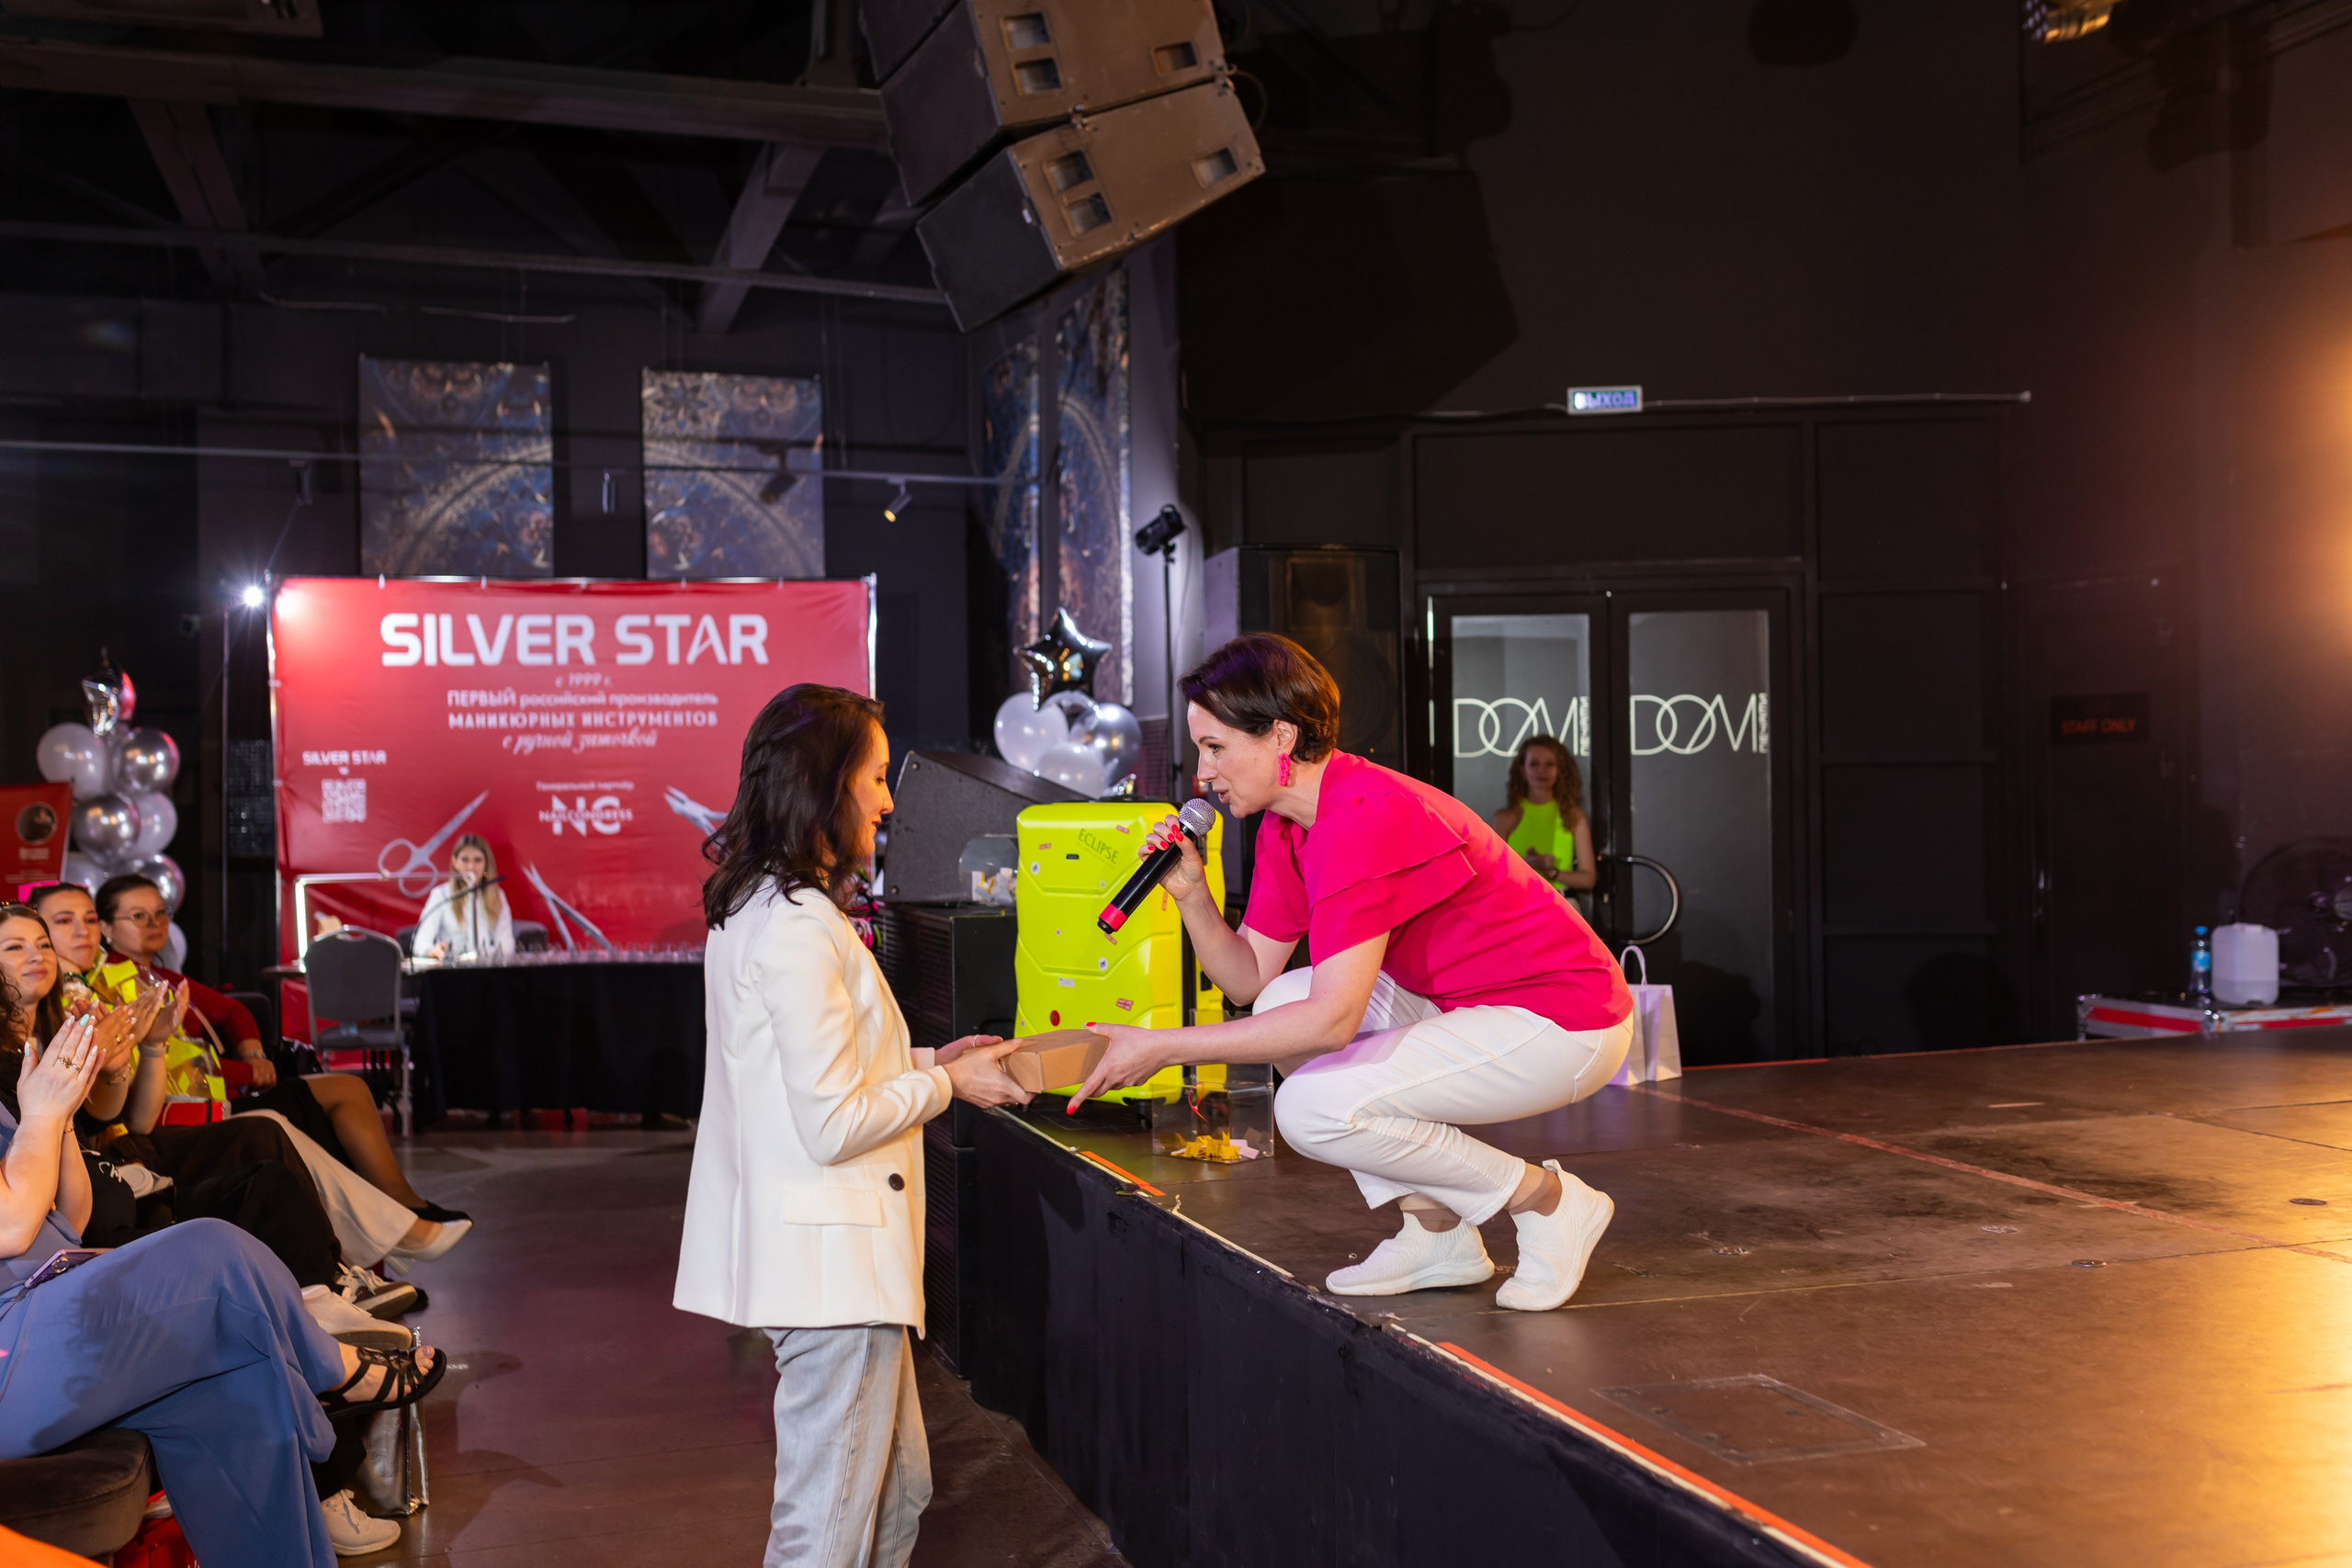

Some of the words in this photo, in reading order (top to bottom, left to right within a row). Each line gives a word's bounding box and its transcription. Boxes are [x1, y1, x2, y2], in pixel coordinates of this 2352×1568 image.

[380, 613, 596, 666] SILVER
[615, 614, 769, 665] STAR
[569, 672, 602, 688] 1999
[447, 687, 516, 707] ПЕРВЫЙ
[520, 691, 605, 710] российский
[608, 693, 718, 709] производитель
[448, 712, 575, 728] МАНИКЮРНЫХ
[582, 710, 718, 727] ИНСТРУМЕНТОВ
[2100, 718, 2136, 733] ONLY
[302, 750, 349, 765] SILVER
[352, 750, 387, 765] STAR
[1078, 828, 1119, 864] ECLIPSE
